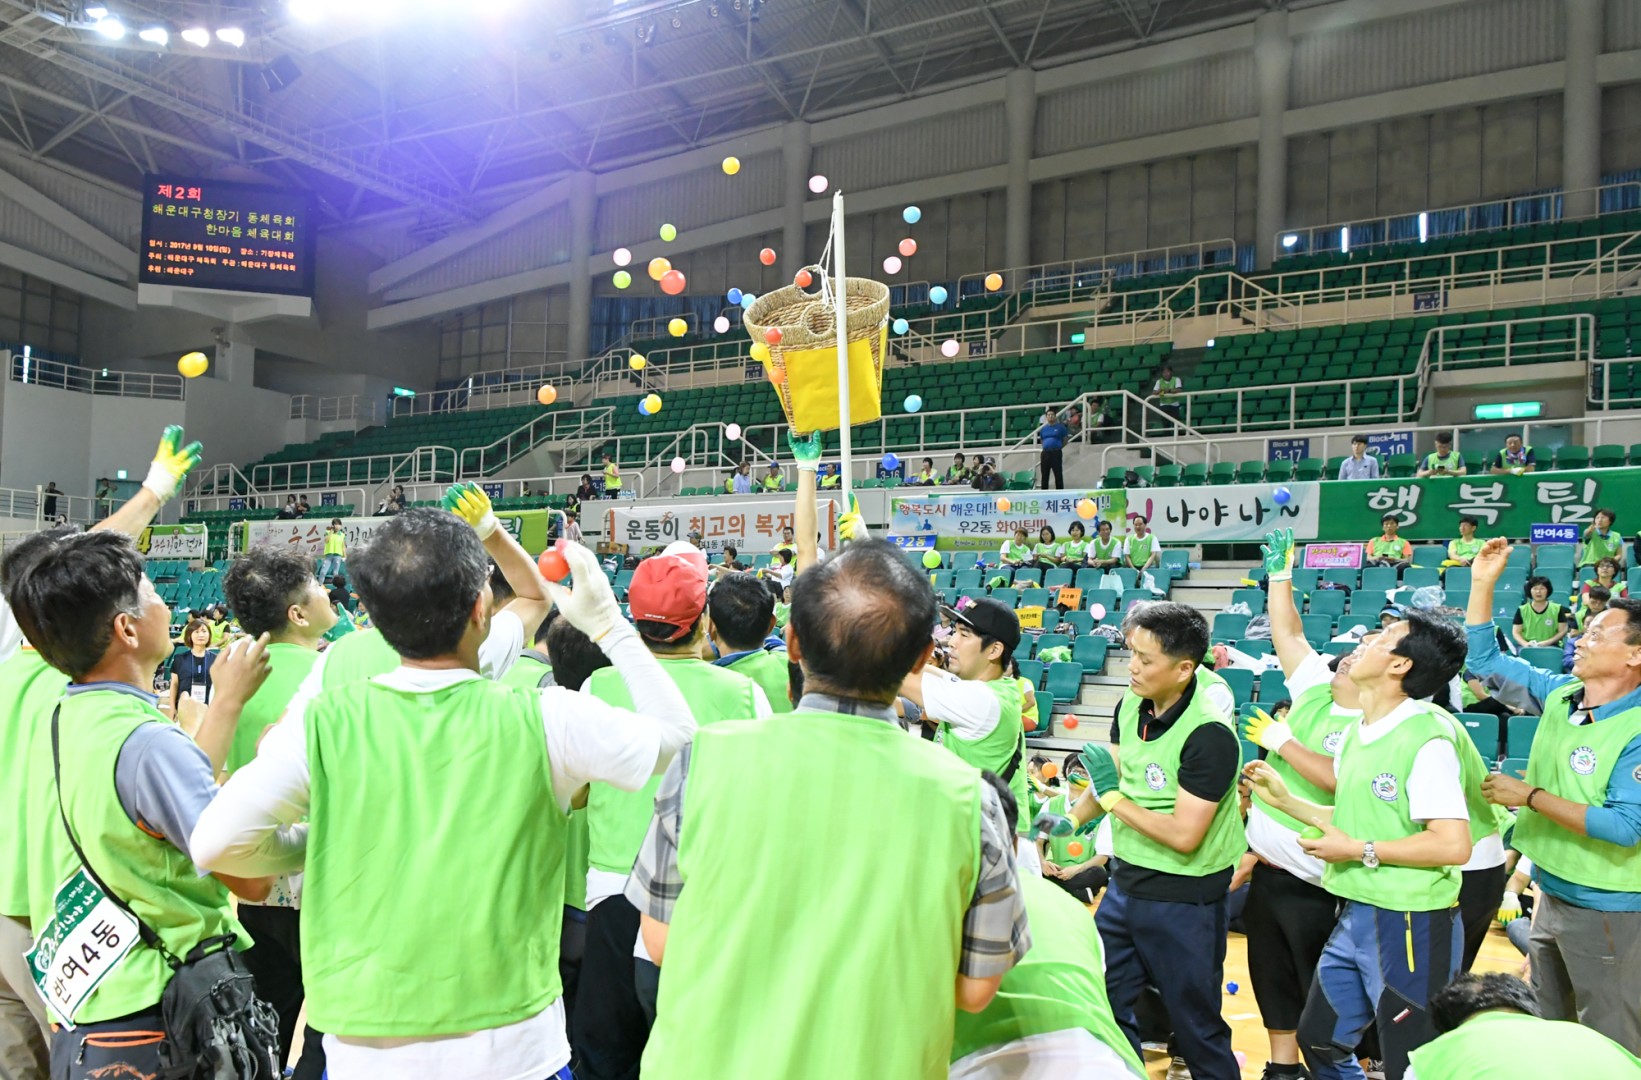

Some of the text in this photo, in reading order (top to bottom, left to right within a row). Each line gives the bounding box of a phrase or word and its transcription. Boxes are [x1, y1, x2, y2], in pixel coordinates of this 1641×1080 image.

[157, 184, 202, 201] 제2회
[152, 203, 295, 227] 해운대구청장기 동체육회
[206, 223, 295, 243] 한마음 체육대회
[899, 503, 946, 517] 행복도시
[1166, 498, 1229, 527] 나야
[626, 518, 679, 541] 운동이
[689, 513, 746, 539] 최고의
[958, 520, 992, 534] 우2동
[1533, 527, 1576, 540] 반여4동
[288, 524, 322, 552] 우승
[894, 536, 927, 548] 우2동
[53, 919, 120, 1005] 반여4동
